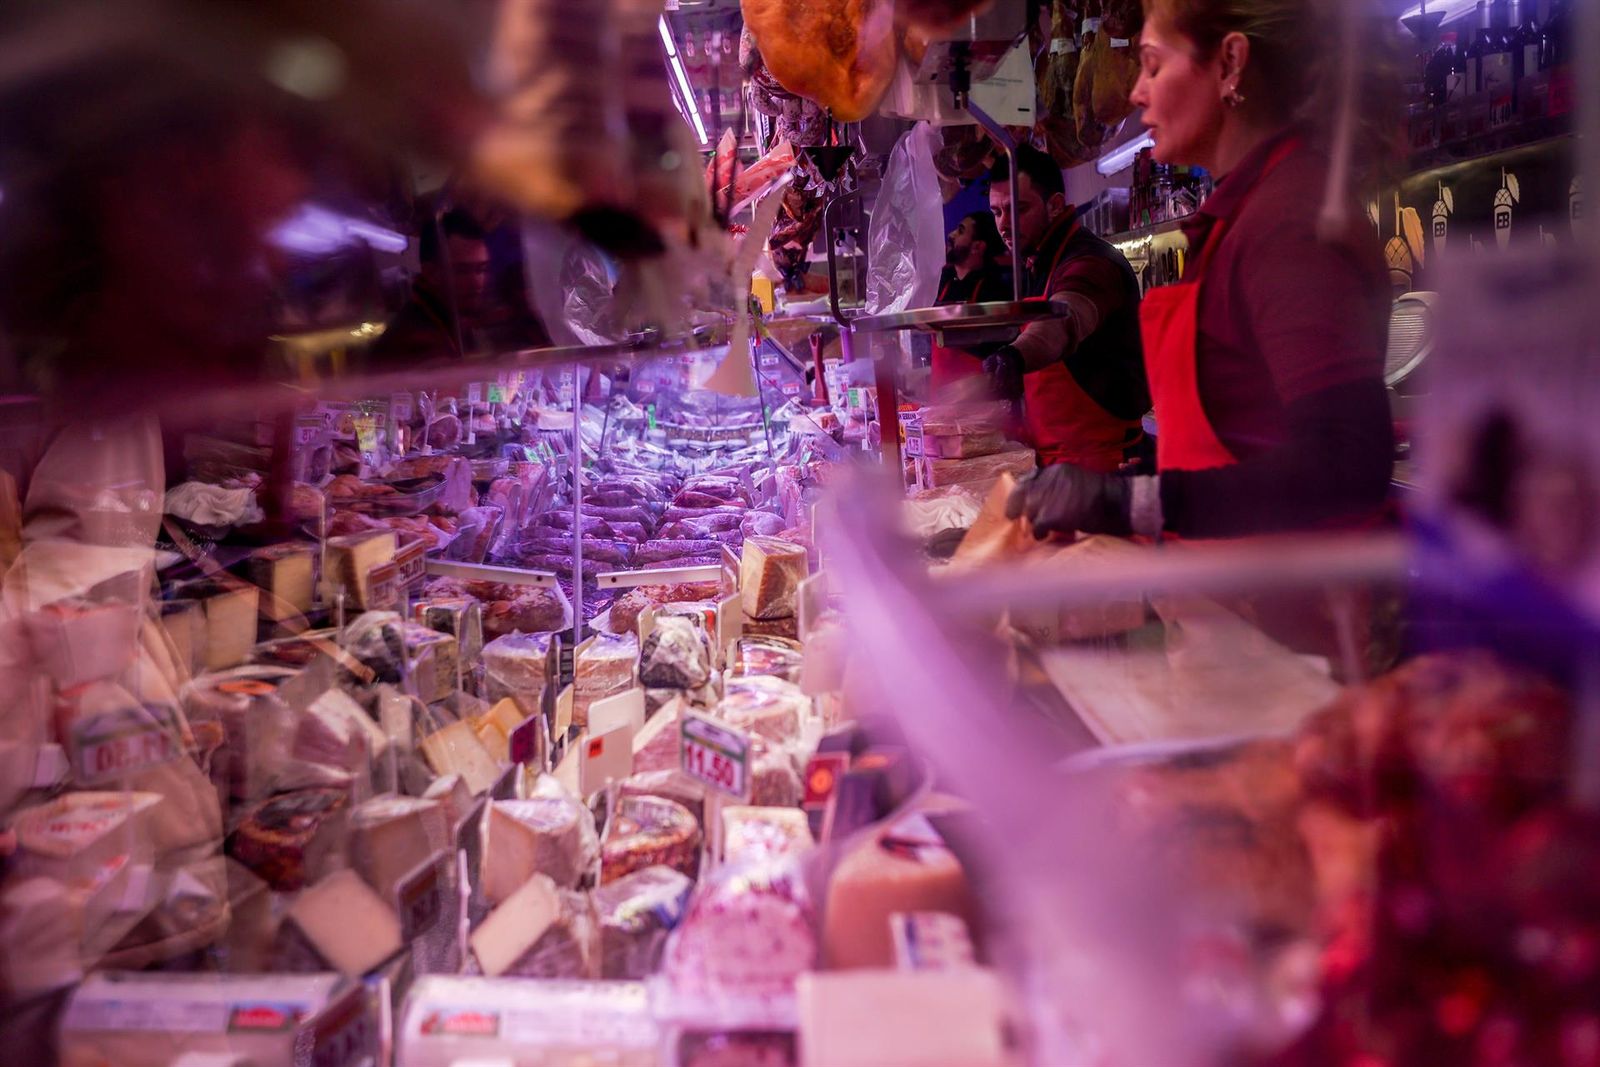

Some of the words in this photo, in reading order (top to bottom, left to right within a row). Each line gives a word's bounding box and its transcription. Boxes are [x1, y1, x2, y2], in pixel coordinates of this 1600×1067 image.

[1496, 211, 1510, 229] EB
[1434, 221, 1446, 238] EB
[686, 744, 734, 788] 11.50
